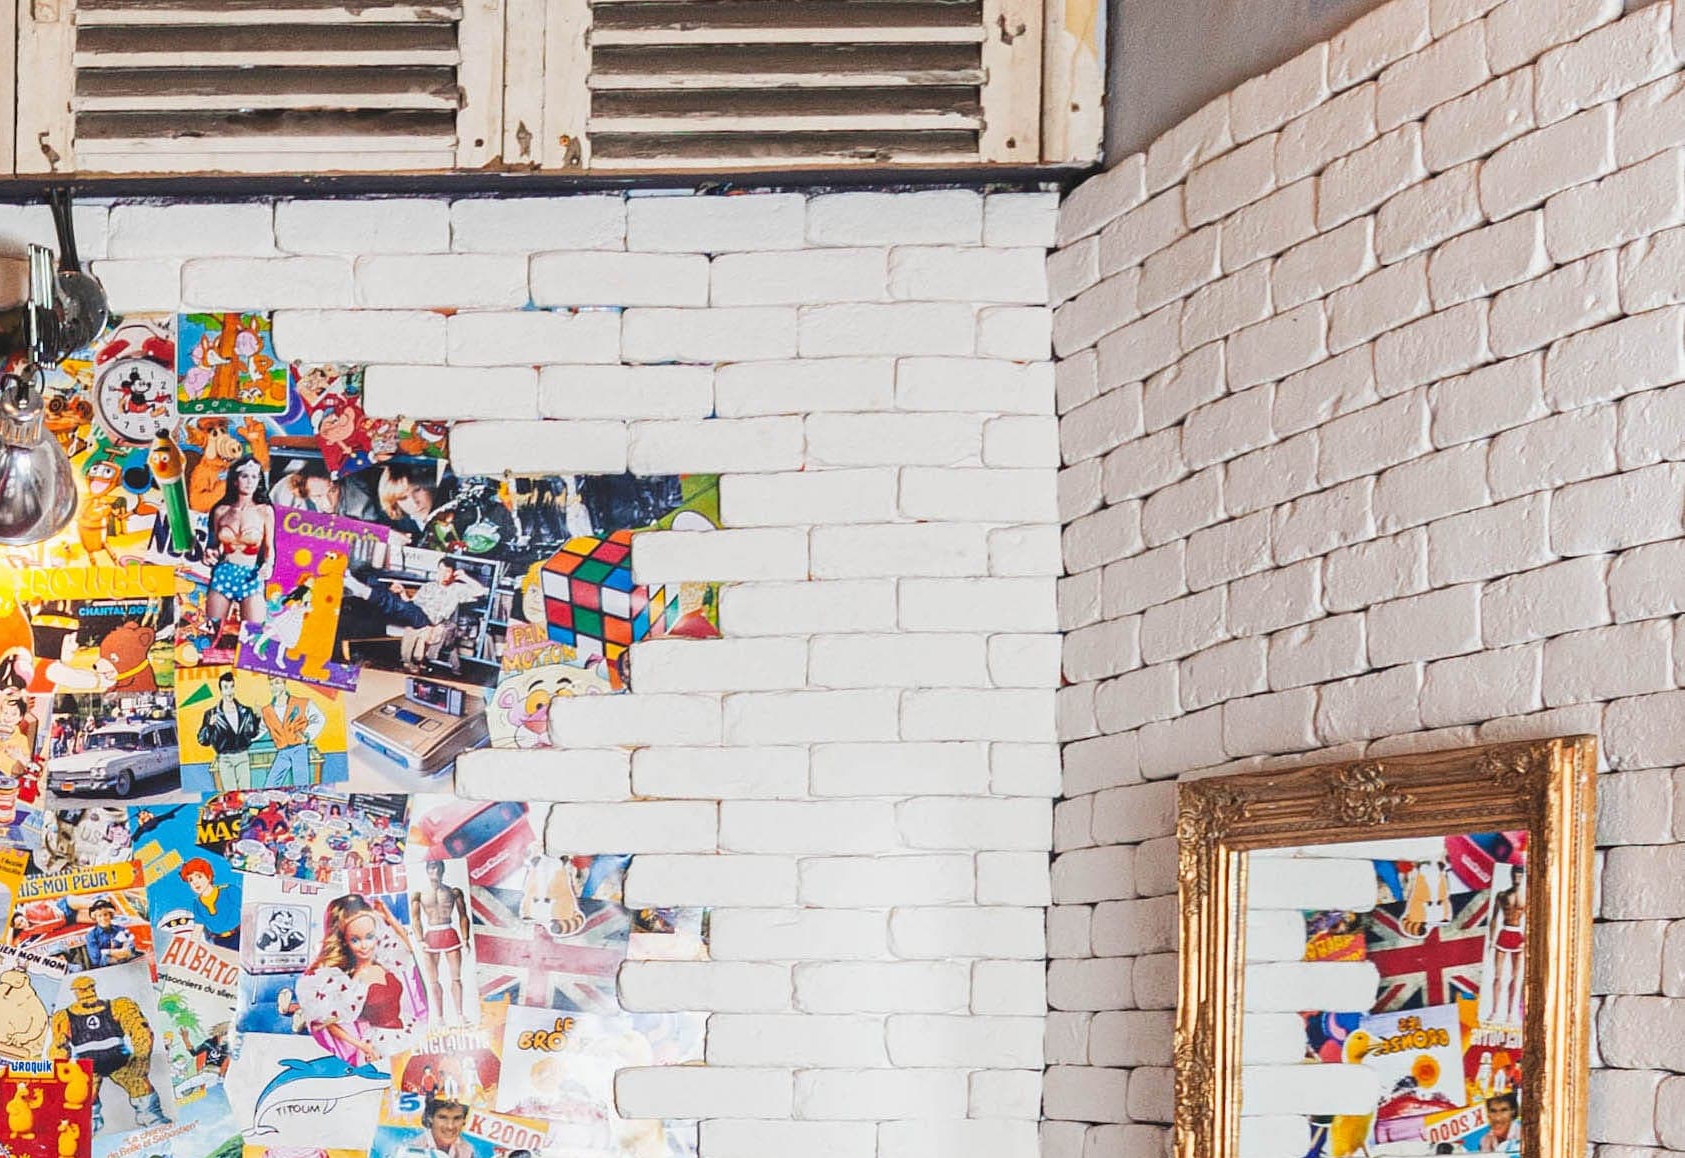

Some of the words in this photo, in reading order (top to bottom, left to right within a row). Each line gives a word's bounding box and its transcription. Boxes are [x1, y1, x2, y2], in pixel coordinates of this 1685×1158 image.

[78, 605, 126, 617] CHANTAL
[69, 867, 108, 891] PEUR
[161, 936, 240, 986] ALBATO
[275, 1104, 322, 1116] TITOUM
[468, 1113, 486, 1136] K
